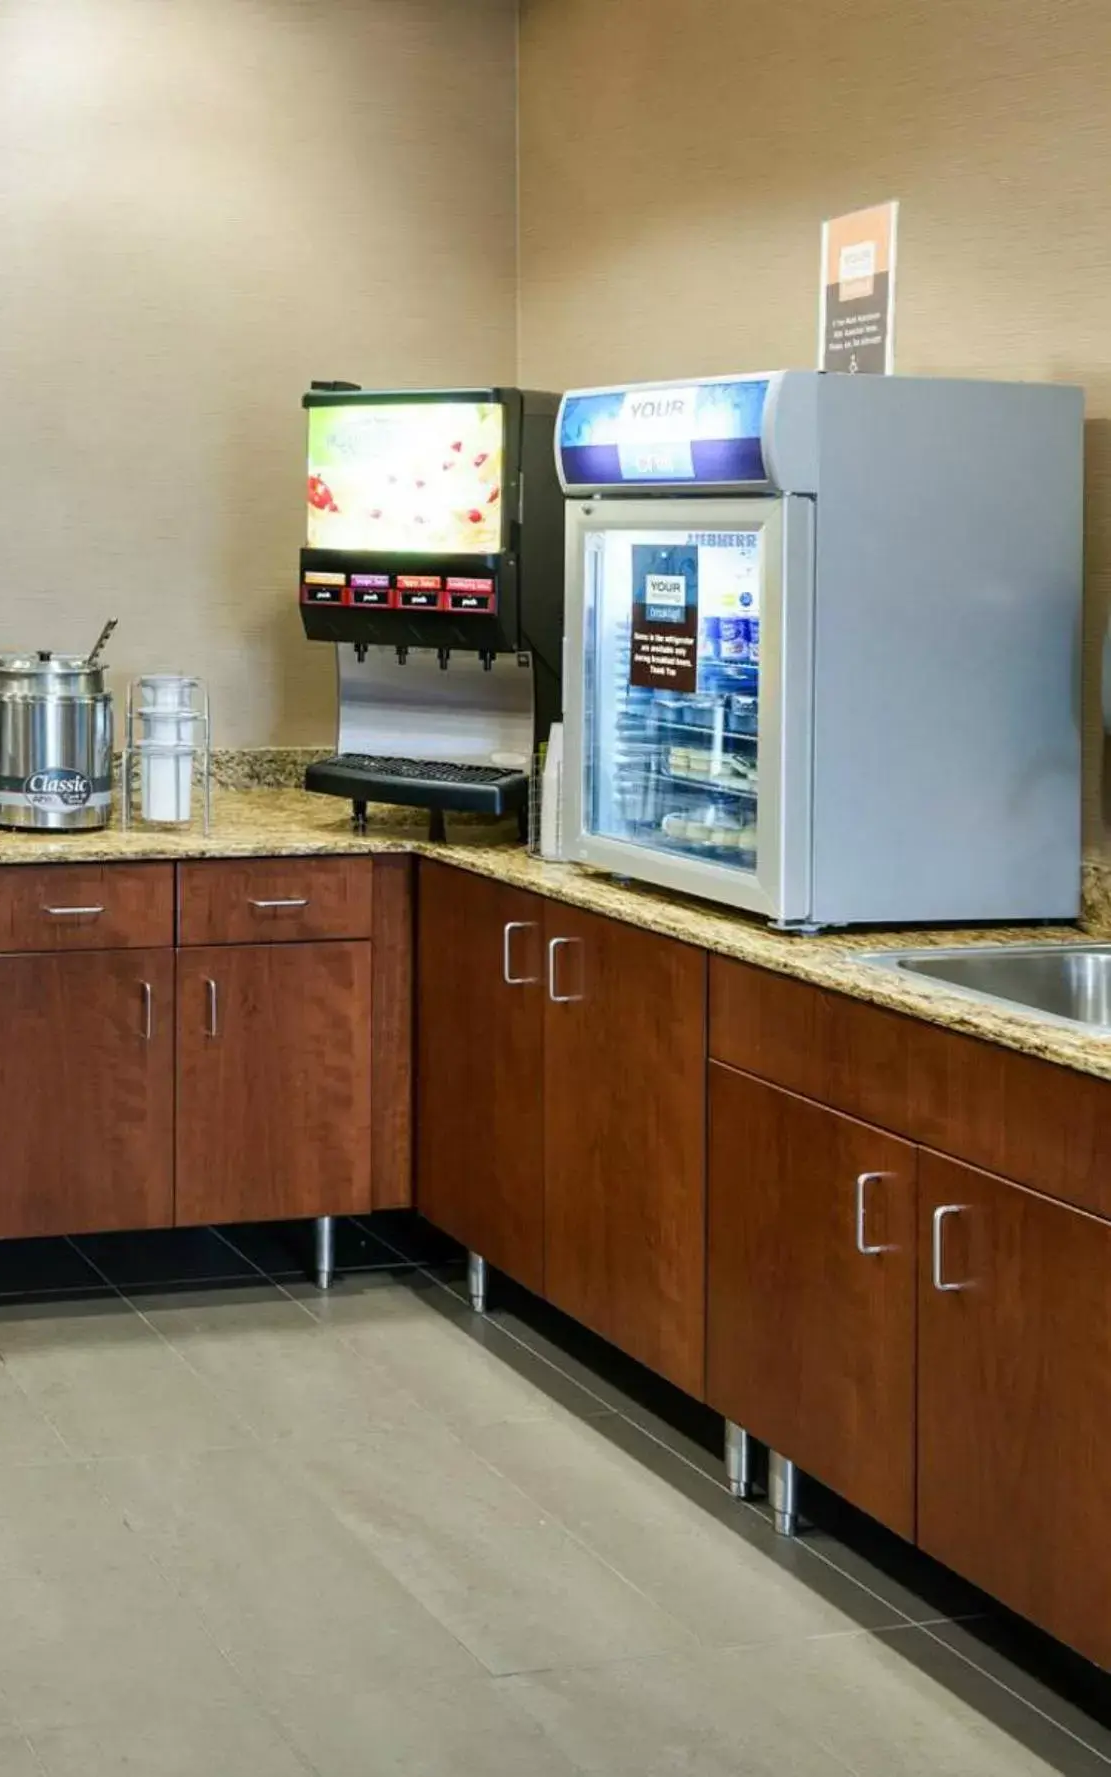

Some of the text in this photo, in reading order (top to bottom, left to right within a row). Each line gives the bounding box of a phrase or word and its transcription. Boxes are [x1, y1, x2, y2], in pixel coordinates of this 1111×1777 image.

[631, 400, 684, 418] YOUR
[651, 581, 681, 593] YOUR
[30, 774, 87, 793] Classic
